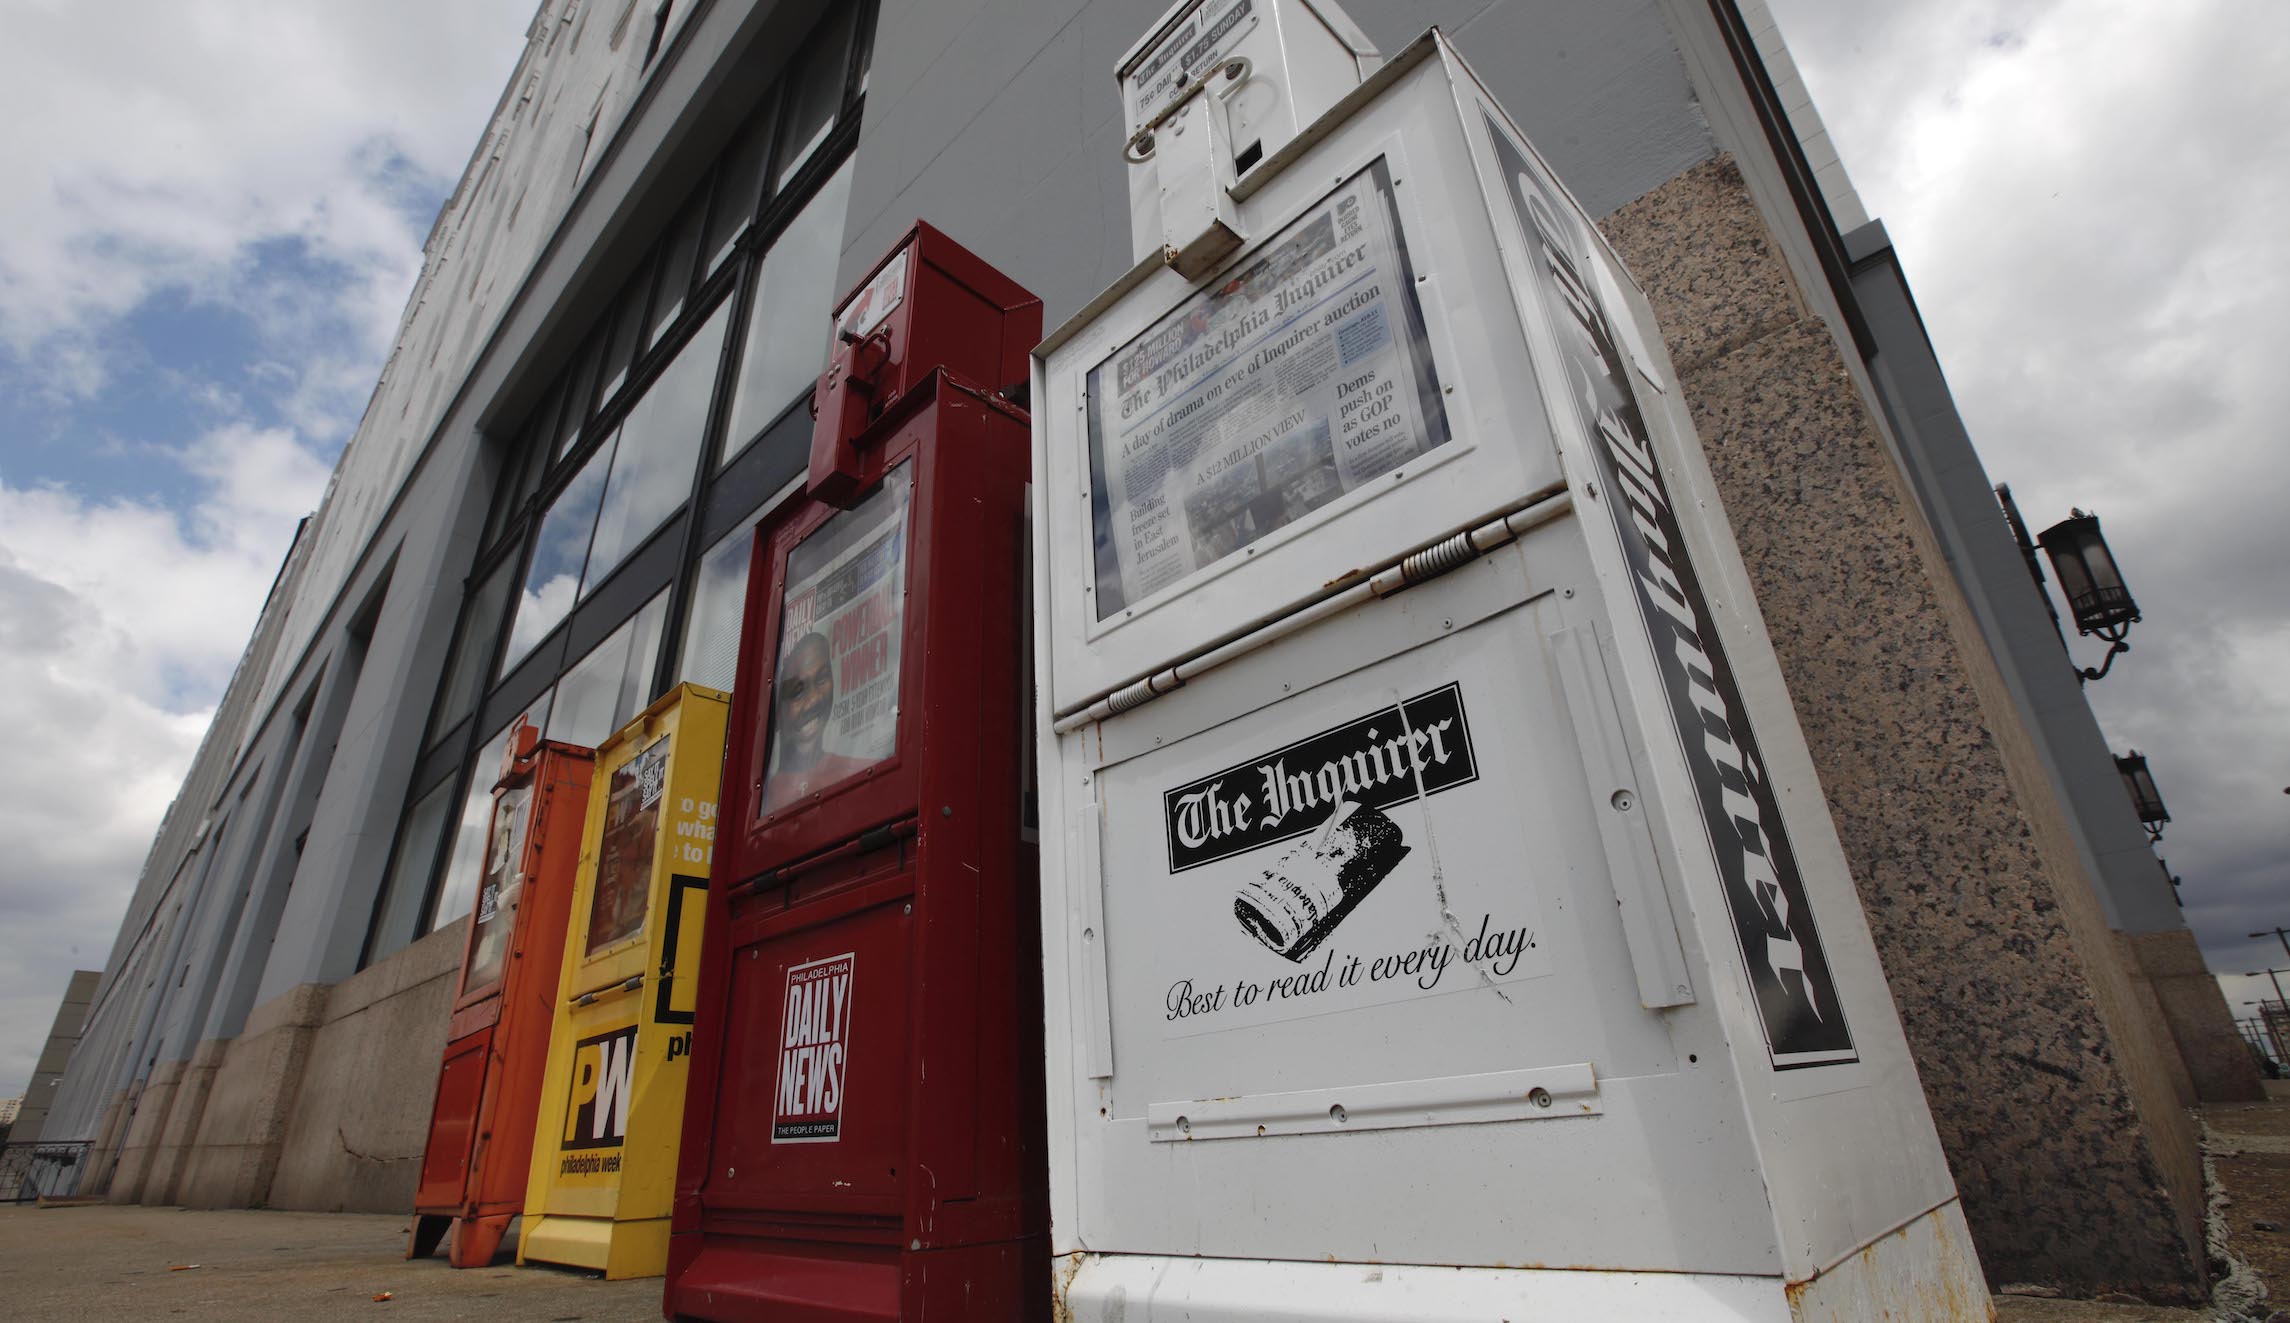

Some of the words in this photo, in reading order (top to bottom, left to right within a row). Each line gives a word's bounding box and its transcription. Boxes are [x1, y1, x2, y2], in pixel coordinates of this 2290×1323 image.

[1157, 66, 1177, 93] DAIL
[1185, 41, 1208, 66] $1.75
[1211, 5, 1246, 41] SUNDAY
[1191, 50, 1218, 76] RETURN
[1120, 388, 1151, 419] The
[1156, 308, 1270, 398] Philadelphia
[1274, 243, 1366, 320] Inquirer
[1147, 321, 1184, 359] MILLION
[1122, 443, 1131, 459] A
[1132, 432, 1152, 452] day
[1153, 418, 1166, 437] of
[1167, 397, 1205, 427] drama
[1206, 384, 1222, 401] on
[1224, 369, 1245, 389] eve
[1247, 353, 1263, 375] of
[1262, 321, 1321, 365] Inquirer
[1323, 285, 1381, 327] auction
[1336, 370, 1376, 399] Dems
[1340, 389, 1373, 419] push
[1375, 380, 1393, 396] on
[1343, 418, 1358, 433] as
[1360, 394, 1393, 422] GOP
[1197, 473, 1205, 486] A
[1206, 460, 1222, 480] $12
[1223, 432, 1272, 468] MILLION
[1273, 409, 1306, 438] VIEW
[1345, 424, 1380, 450] votes
[1382, 413, 1401, 431] no
[1129, 493, 1166, 523] Building
[1131, 513, 1156, 537] freeze
[1157, 506, 1171, 523] set
[1133, 538, 1143, 551] in
[1144, 526, 1164, 545] East
[1136, 534, 1179, 565] Jerusalem
[787, 595, 814, 632] DAILY
[841, 631, 888, 693] WINNER
[1571, 353, 1824, 1025] Inquirer
[1174, 779, 1254, 849] The
[1256, 716, 1453, 832] Inquirer
[683, 842, 703, 863] to
[791, 962, 849, 984] PHILADELPHIA
[1166, 976, 1228, 1021] Best
[1233, 978, 1266, 1008] to
[1266, 949, 1334, 1002] read
[1338, 953, 1366, 987] it
[1369, 941, 1456, 990] every
[1463, 913, 1537, 976] day.
[785, 973, 848, 1048] DAILY
[564, 1033, 638, 1142] PW
[779, 1042, 842, 1116] NEWS
[778, 1126, 789, 1135] THE
[789, 1125, 813, 1135] PEOPLE
[813, 1124, 835, 1134] PAPER
[560, 1153, 600, 1178] philadelphia
